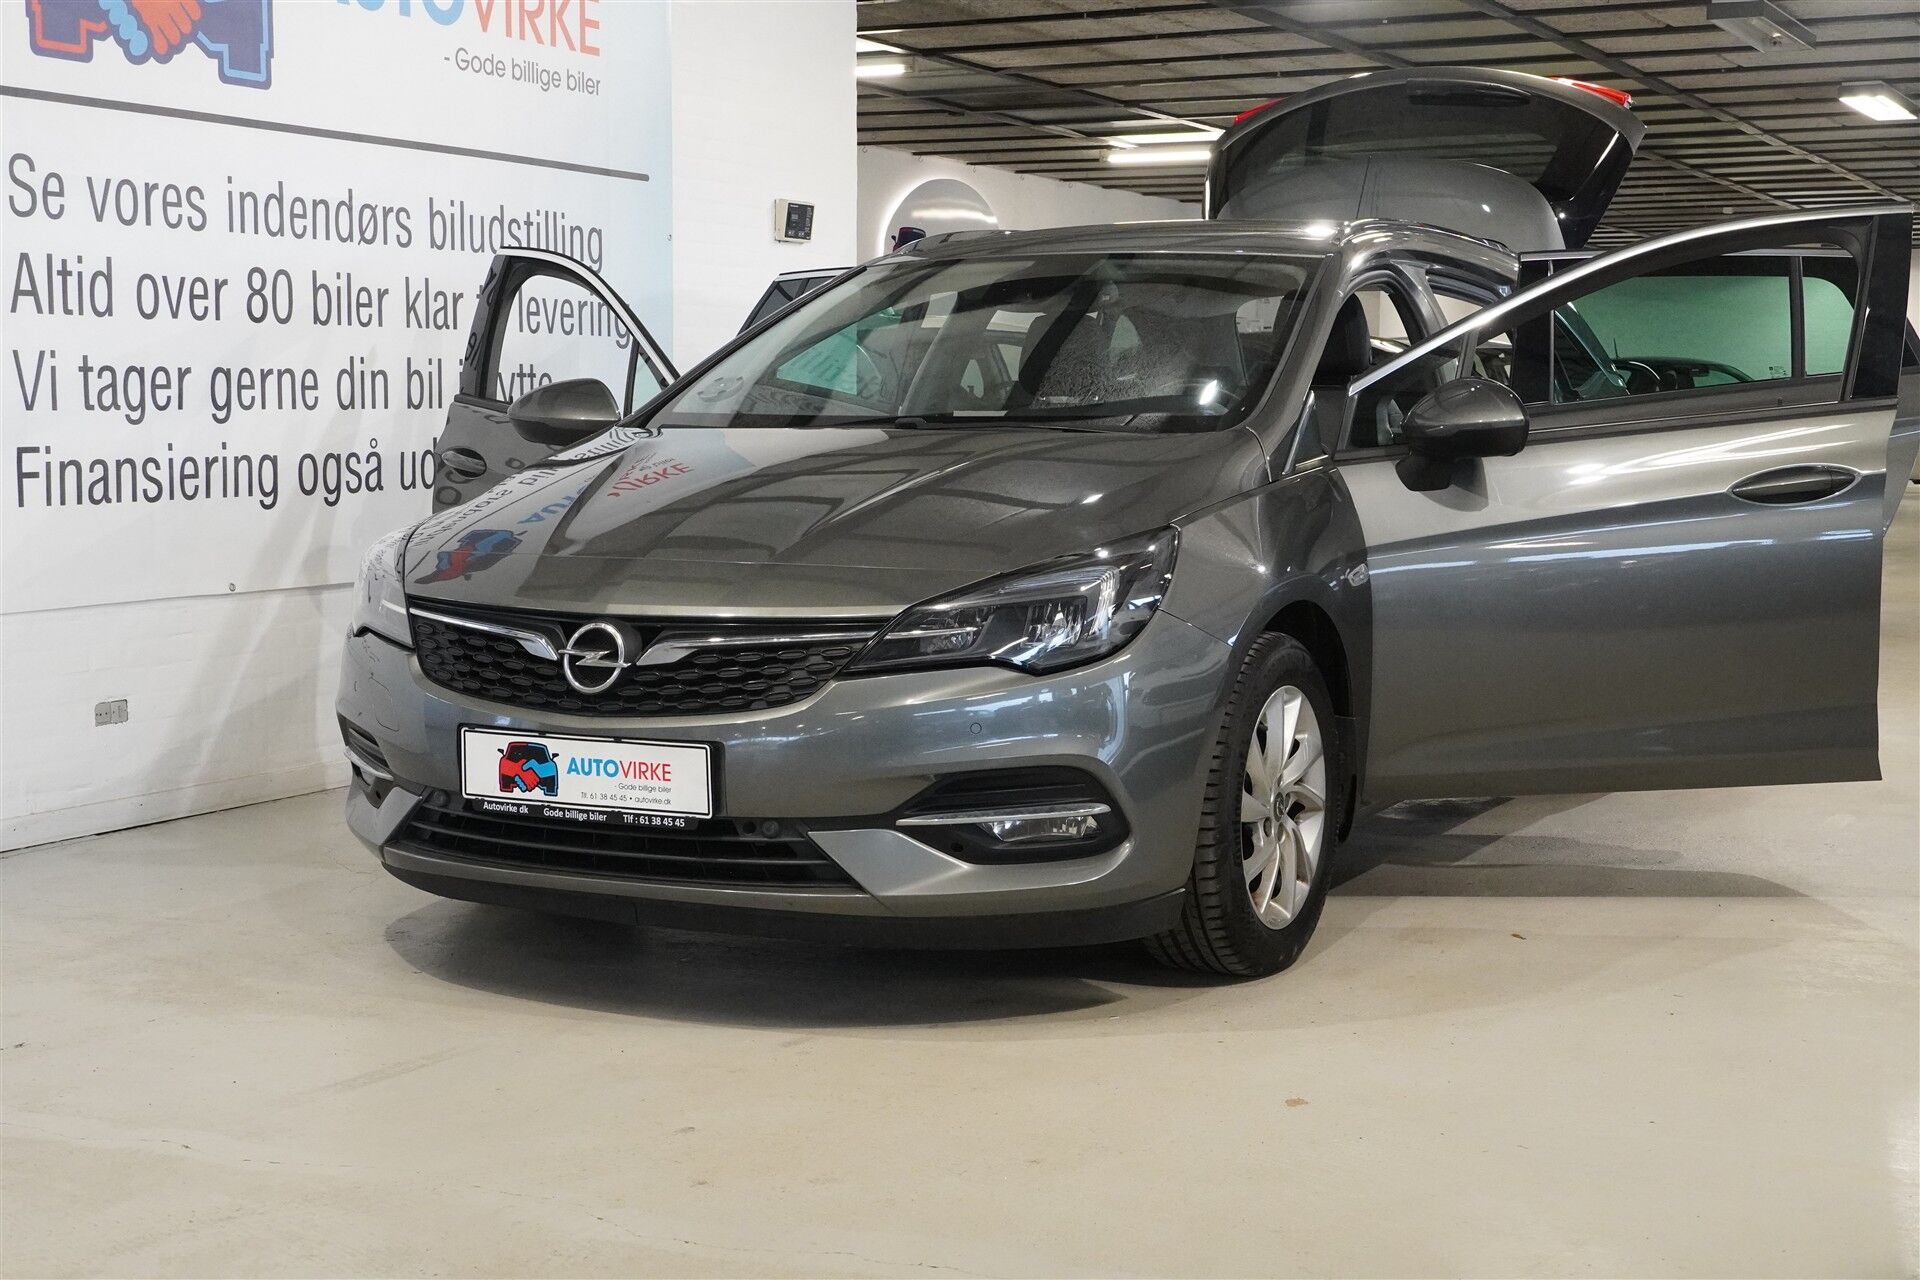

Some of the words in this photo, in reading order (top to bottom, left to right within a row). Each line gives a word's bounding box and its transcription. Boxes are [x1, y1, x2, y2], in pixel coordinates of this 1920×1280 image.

[455, 47, 506, 77] Gode
[511, 57, 561, 92] billige
[566, 69, 600, 96] biler
[8, 153, 65, 220] Se
[86, 175, 208, 232] vores
[227, 175, 413, 249] indendørs
[428, 196, 603, 274] biludstilling
[10, 252, 114, 318] Altid
[136, 273, 229, 321] over
[246, 266, 294, 325] 80
[311, 269, 389, 328] biler
[404, 276, 464, 330] klar
[518, 285, 630, 349] levering
[12, 349, 58, 411] Vi
[78, 354, 192, 425] tager
[210, 366, 319, 424] gerne
[336, 356, 389, 411] din
[406, 357, 443, 410] bil
[16, 441, 279, 510] Finansiering
[297, 437, 384, 507] også
[566, 757, 672, 782] AUTOVIRKE
[618, 782, 637, 791] Gode
[638, 783, 657, 793] billige
[482, 801, 518, 813] Autovirke
[518, 805, 529, 814] dk
[543, 807, 564, 818] Gode
[564, 809, 588, 822] billige
[589, 811, 608, 822] biler
[622, 814, 634, 824] Tlf
[639, 816, 650, 825] 61
[650, 817, 661, 826] 38
[662, 818, 674, 827] 45
[674, 818, 686, 828] 45
[599, 793, 608, 801] 38
[609, 794, 618, 802] 45
[619, 794, 628, 802] 45
